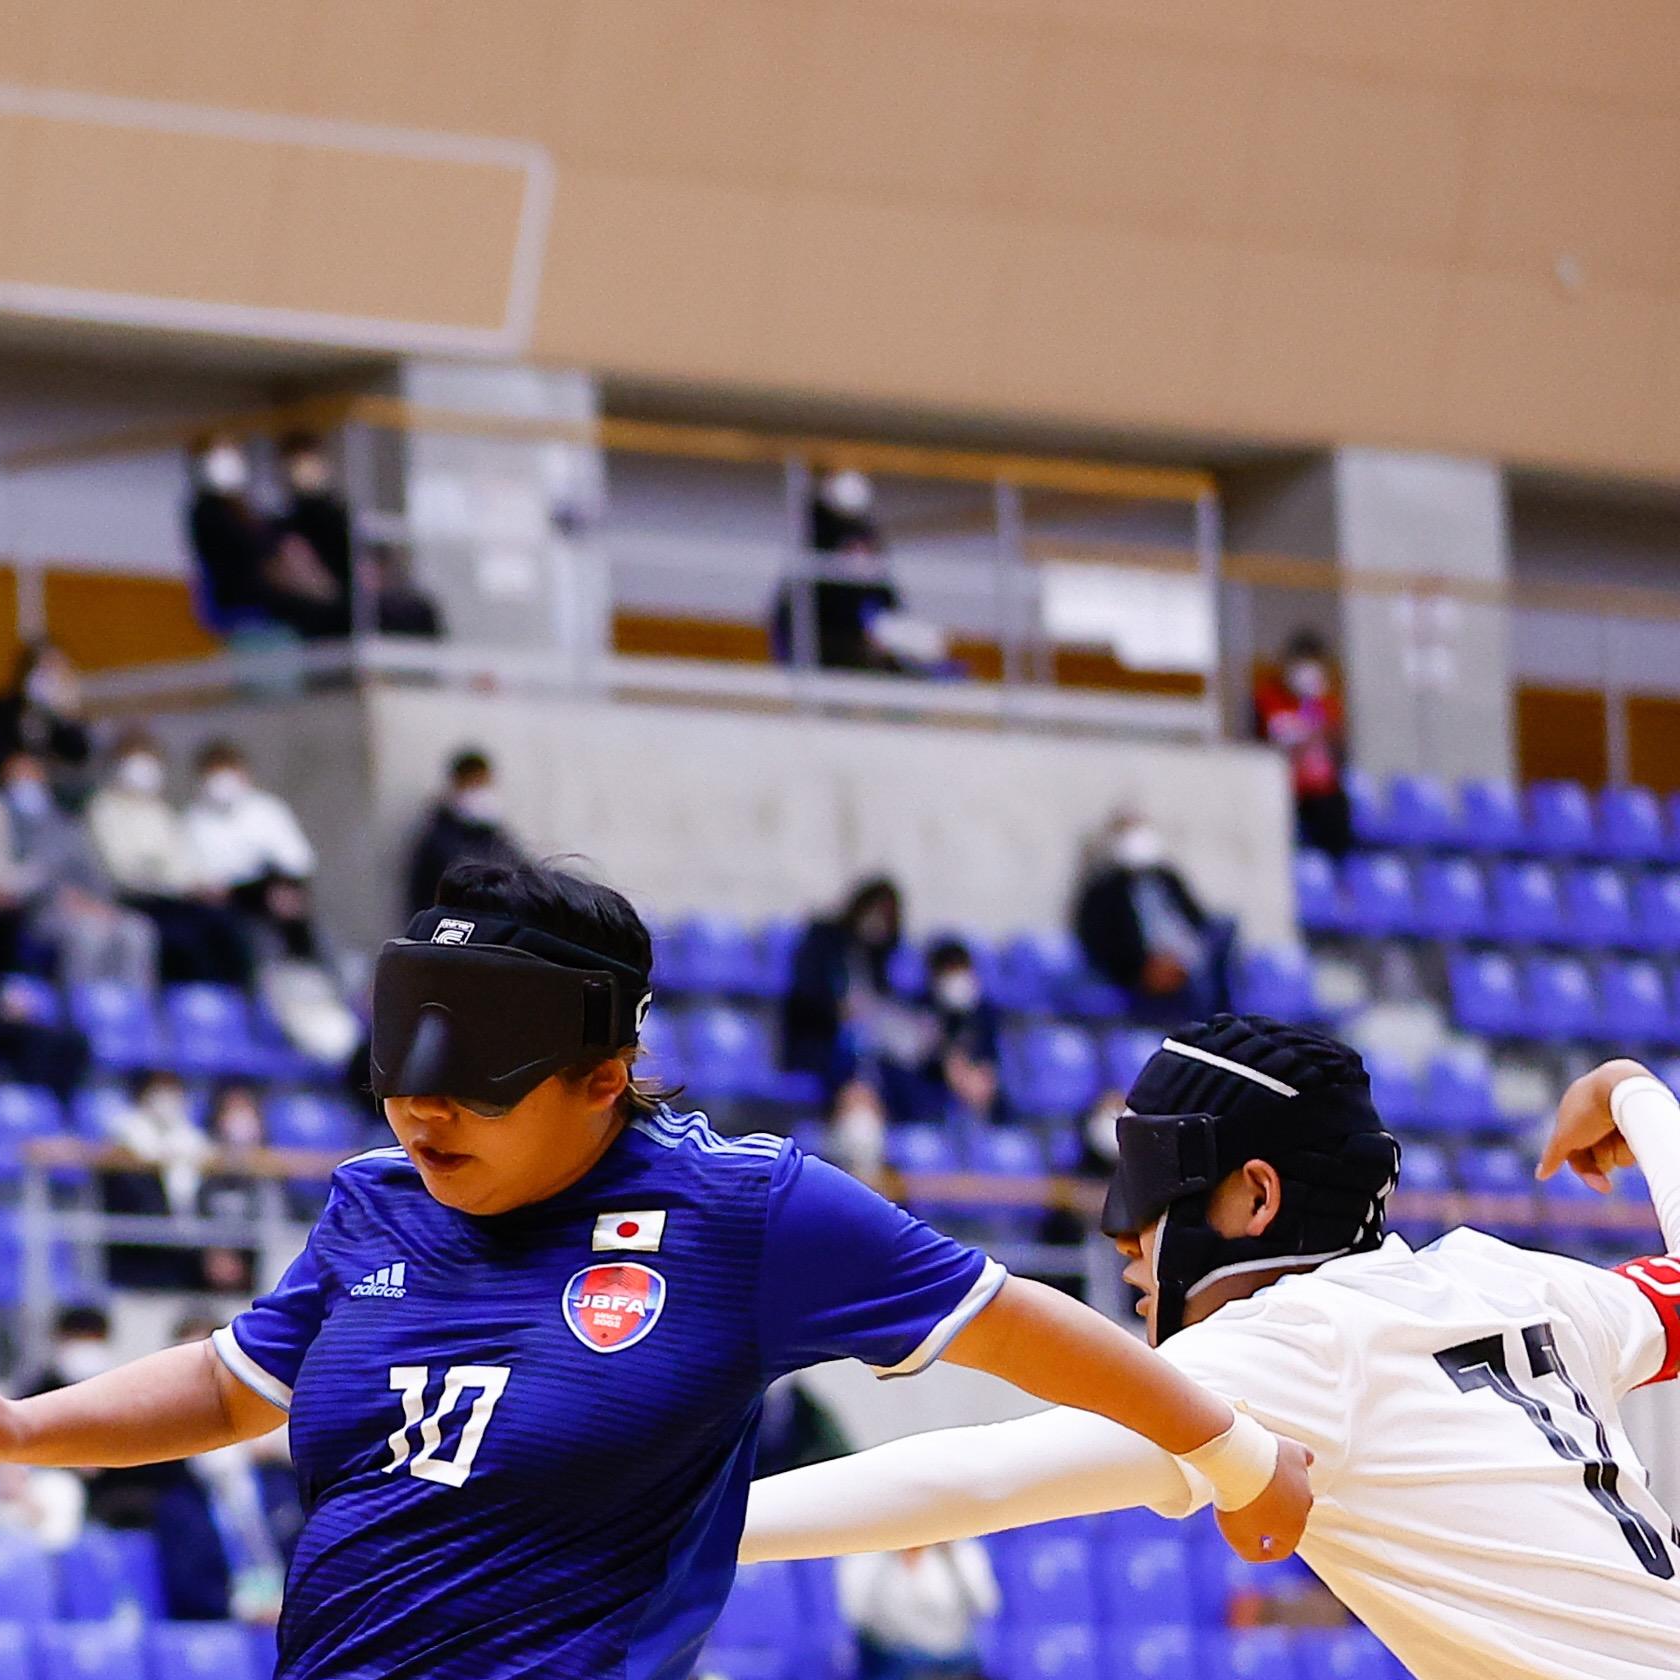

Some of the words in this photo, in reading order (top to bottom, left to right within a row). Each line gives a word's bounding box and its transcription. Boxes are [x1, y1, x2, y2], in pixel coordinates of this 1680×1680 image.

[350, 1282, 407, 1299] adidas
[573, 1294, 646, 1317] JBFA
[381, 1365, 512, 1488] 10
